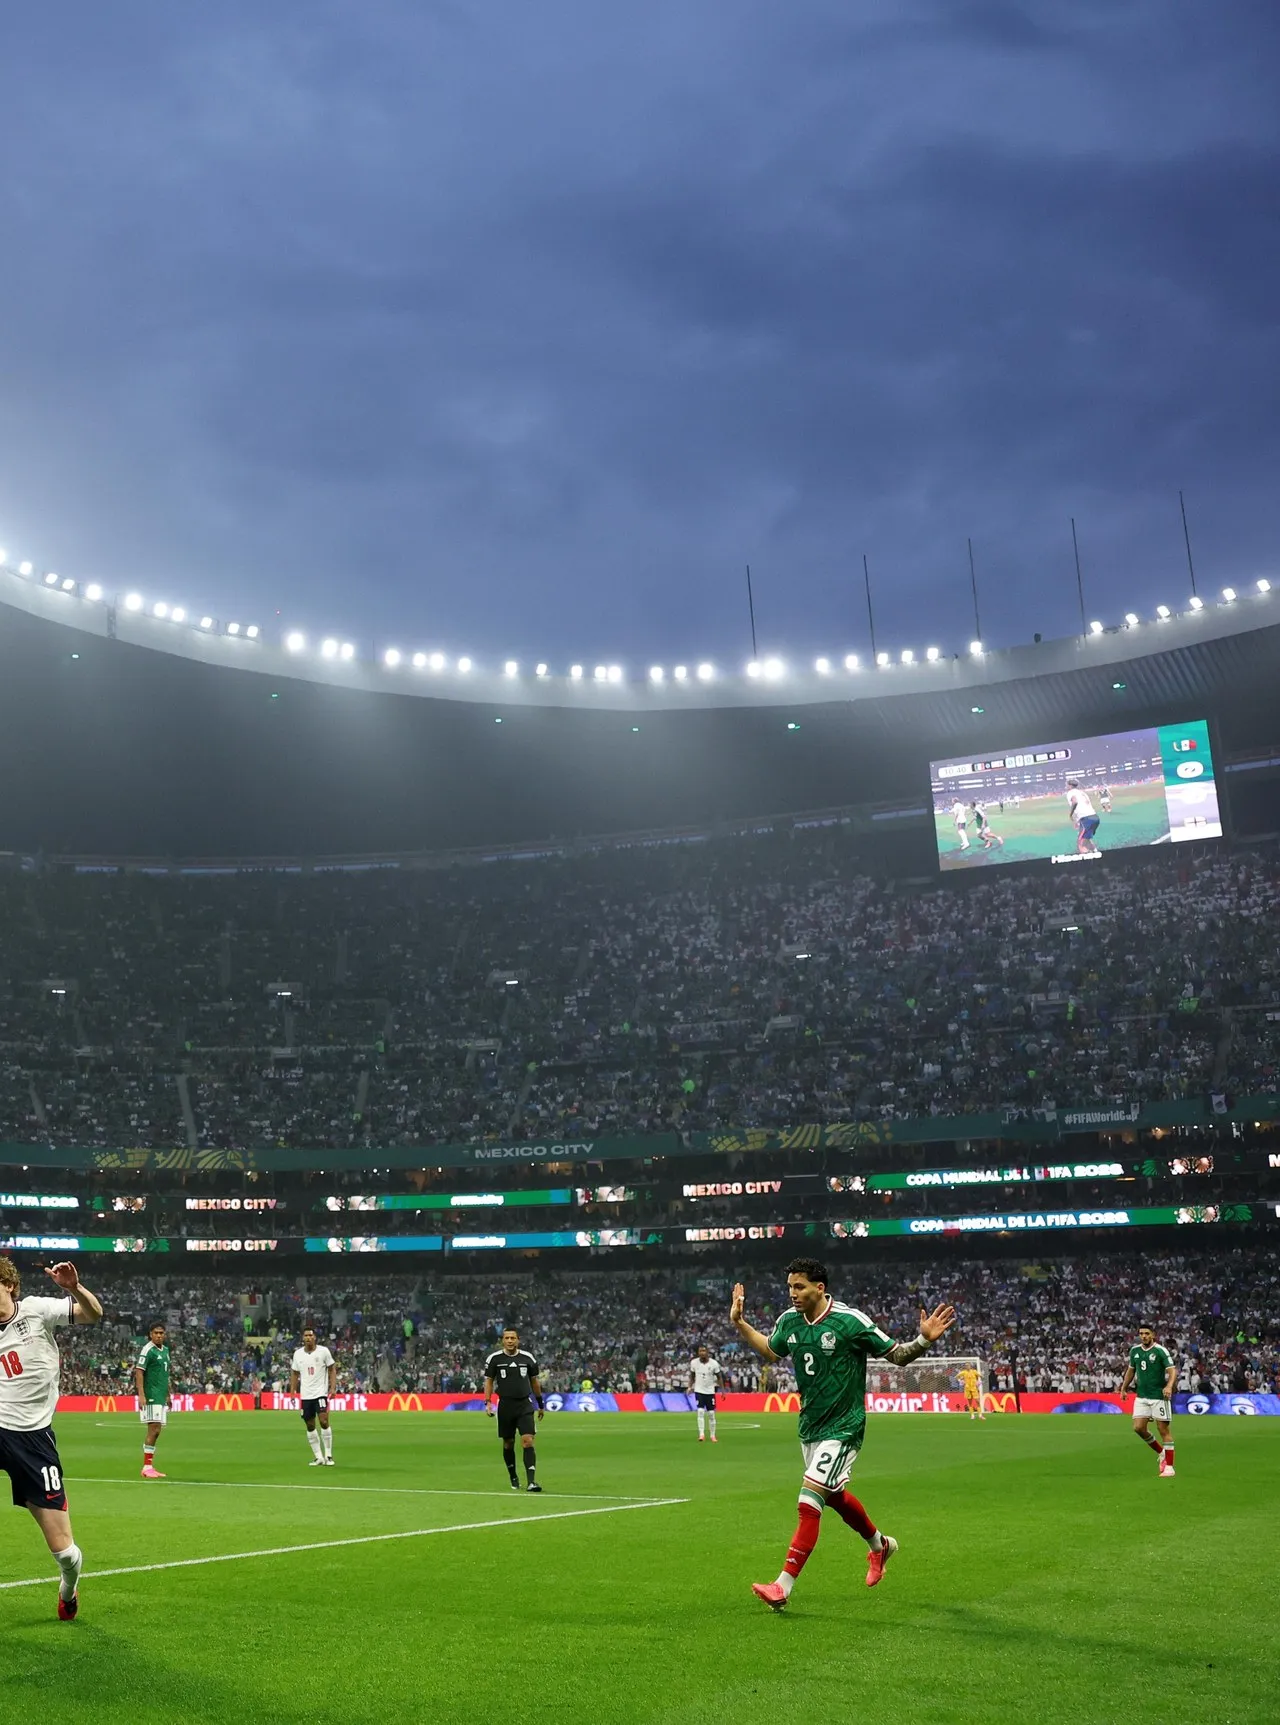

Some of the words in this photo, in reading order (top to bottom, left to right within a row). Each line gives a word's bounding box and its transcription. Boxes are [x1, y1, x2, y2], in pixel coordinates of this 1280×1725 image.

[475, 1146, 547, 1158] MEXICO
[551, 1144, 594, 1154] CITY
[906, 1173, 942, 1186] COPA
[943, 1170, 1002, 1184] MUNDIAL
[1074, 1164, 1124, 1177] 2026
[683, 1183, 742, 1196] MEXICO
[745, 1181, 781, 1194] CITY
[1, 1195, 15, 1206] LA
[186, 1199, 240, 1209] MEXICO
[244, 1199, 277, 1209] CITY
[910, 1219, 943, 1232] COPA
[959, 1216, 1006, 1230] UNDIAL
[1008, 1216, 1026, 1228] DE
[1028, 1215, 1046, 1227] LA
[1047, 1214, 1079, 1226] FIFA
[1079, 1212, 1129, 1225] 2026
[686, 1228, 745, 1241] MEXICO
[186, 1240, 242, 1251] MEXICO
[244, 1240, 277, 1251] CITY
[0, 1351, 23, 1378] 18
[804, 1353, 815, 1376] 2
[1141, 1361, 1146, 1370] 9
[185, 1394, 194, 1411] it
[354, 1394, 367, 1410] it
[867, 1393, 927, 1412] lovin'
[932, 1393, 949, 1412] it
[1160, 1407, 1165, 1416] 9
[816, 1452, 832, 1474] 2
[41, 1466, 61, 1491] 18
